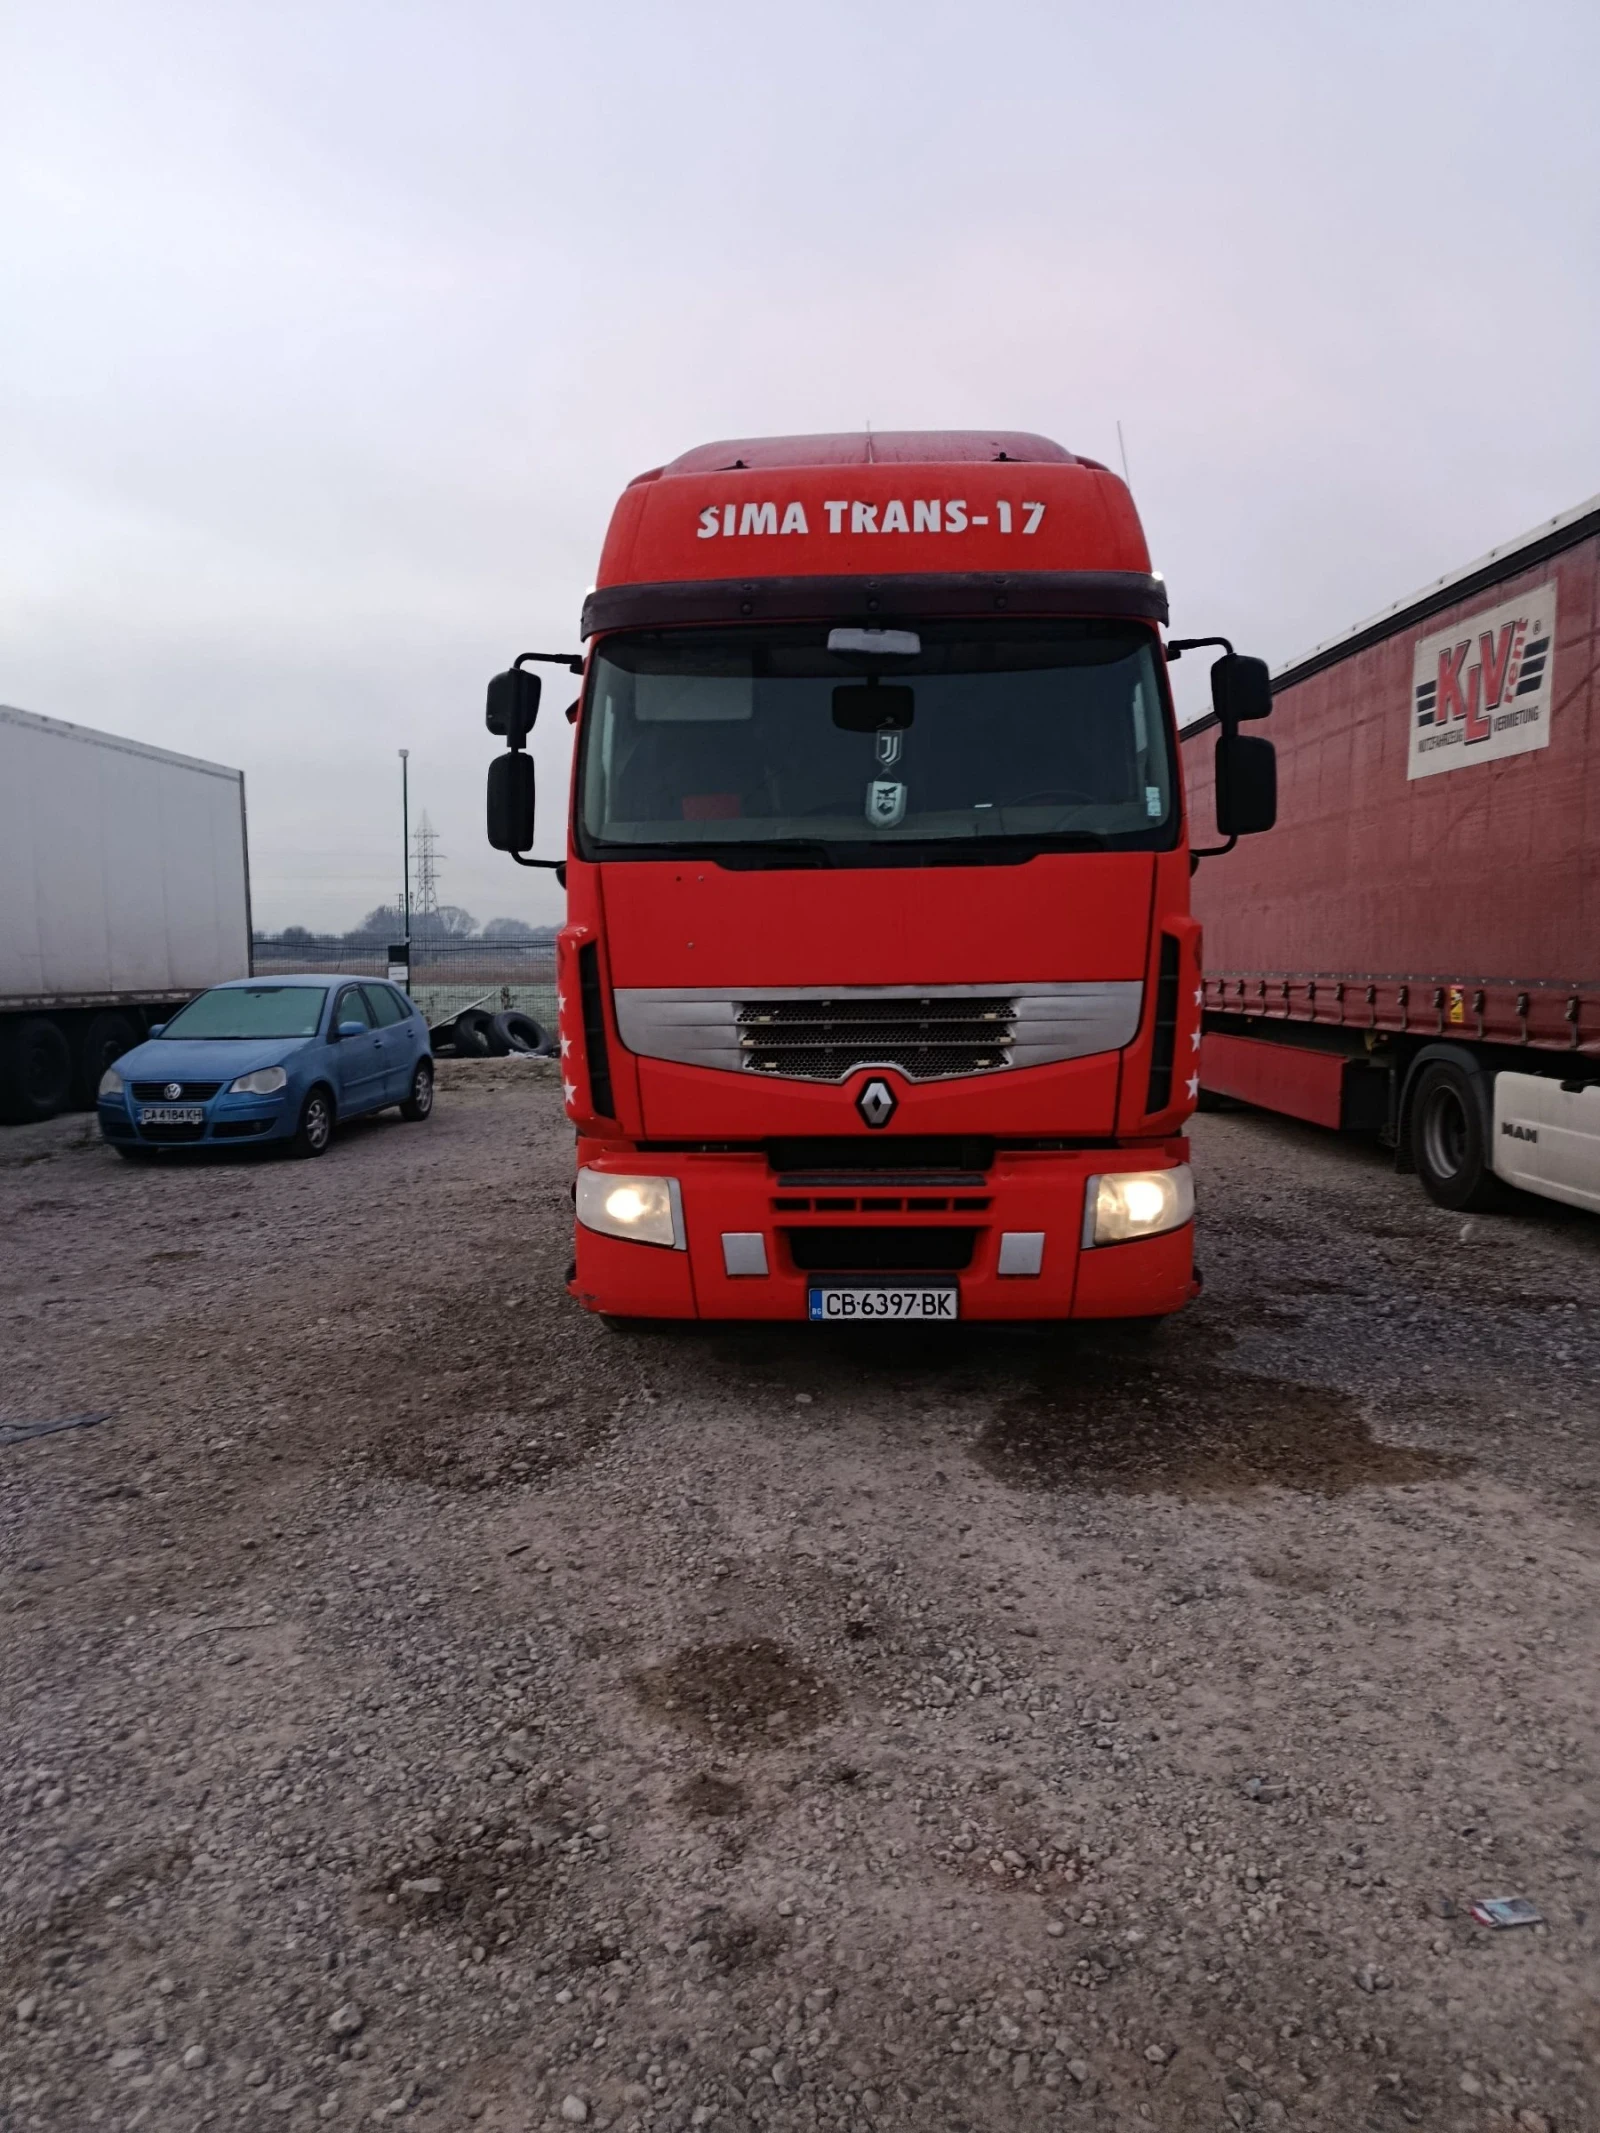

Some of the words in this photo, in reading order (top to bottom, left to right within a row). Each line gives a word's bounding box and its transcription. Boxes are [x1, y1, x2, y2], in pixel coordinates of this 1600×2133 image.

[697, 501, 809, 539] SIMA
[823, 499, 1046, 535] TRANS-17
[1435, 620, 1516, 746] KLV
[1493, 706, 1539, 732] VERMIETUNG
[1501, 1121, 1537, 1144] MAN
[811, 1307, 822, 1315] BG
